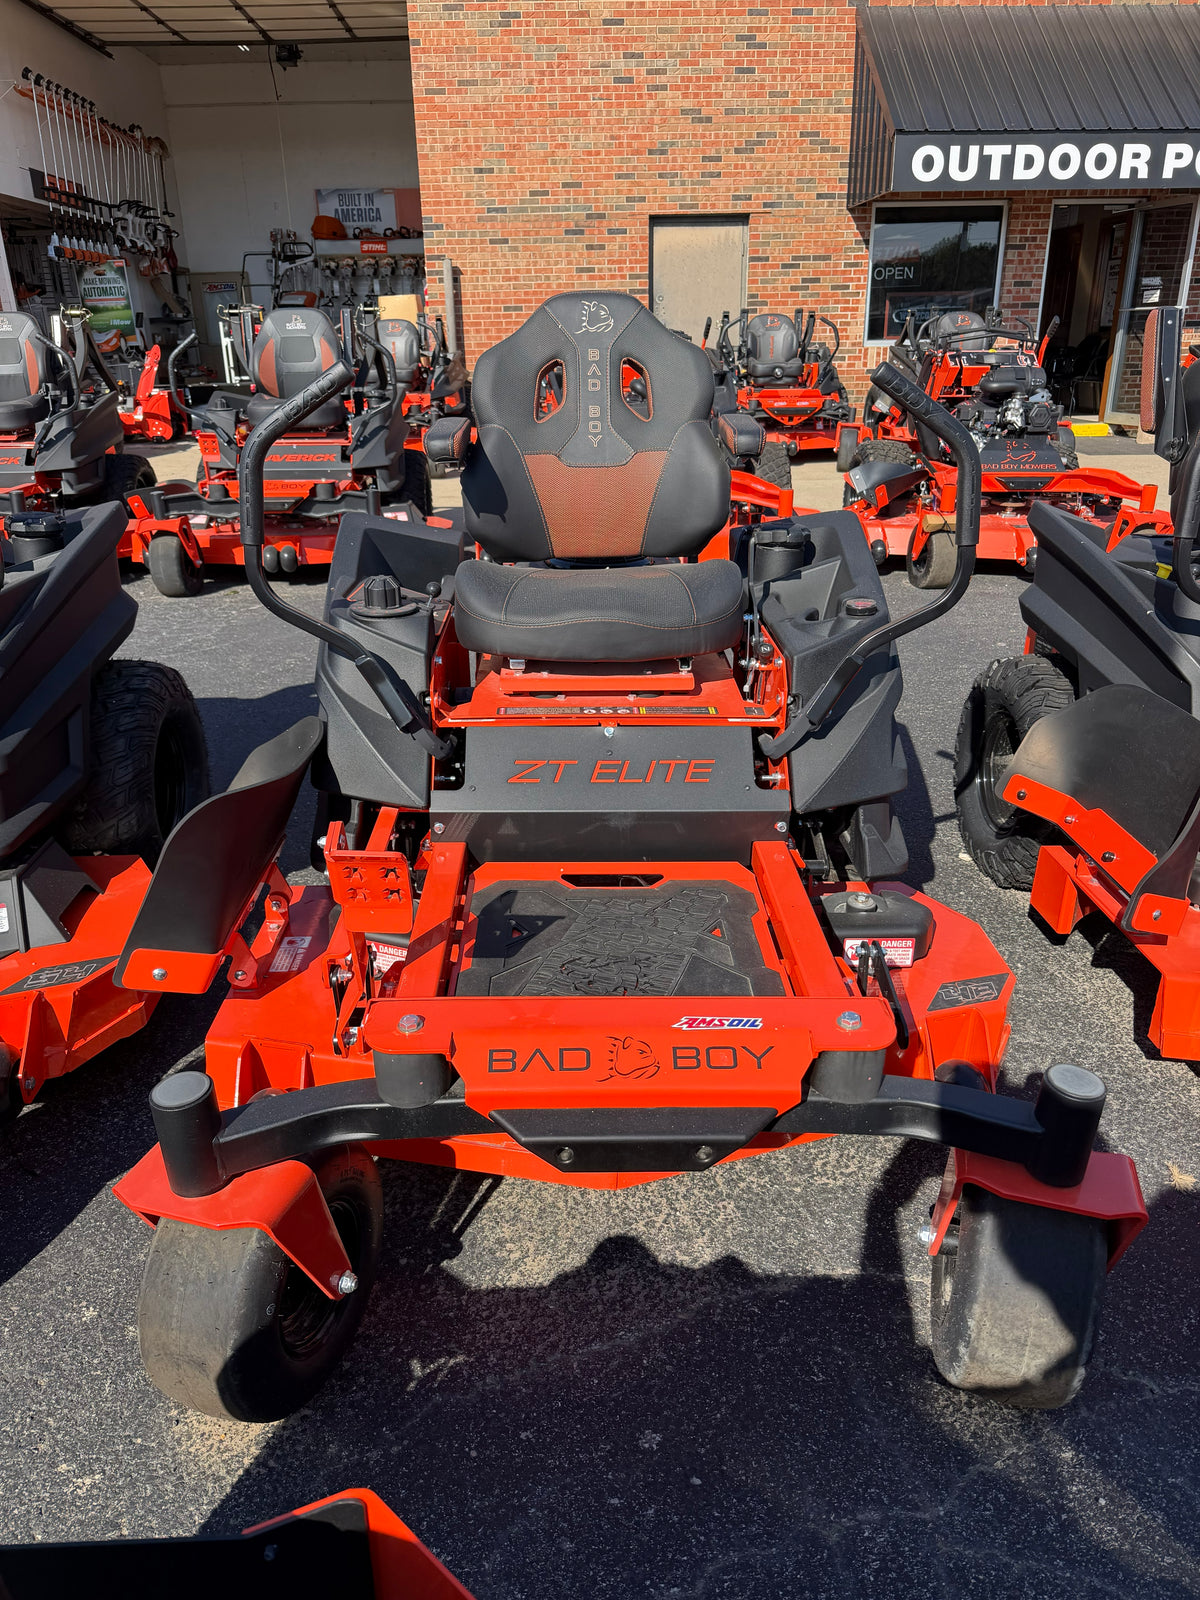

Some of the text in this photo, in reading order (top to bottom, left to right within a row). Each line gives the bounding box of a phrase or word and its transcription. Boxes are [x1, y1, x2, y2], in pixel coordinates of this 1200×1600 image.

[912, 143, 1200, 182] OUTDOOR P
[338, 193, 374, 207] BUILT IN
[334, 208, 382, 222] AMERICA
[362, 243, 387, 251] STIHL
[874, 267, 914, 280] OPEN
[100, 277, 121, 285] MOWING
[83, 286, 126, 297] AUTOMATIC
[588, 348, 602, 447] BAD BOY
[264, 454, 336, 462] AVERICK
[507, 759, 716, 783] ZT ELITE
[881, 940, 912, 948] DANGER
[379, 945, 407, 957] DANGER
[675, 1017, 762, 1029] AMSOIL
[487, 1045, 775, 1073] BAD BOY
